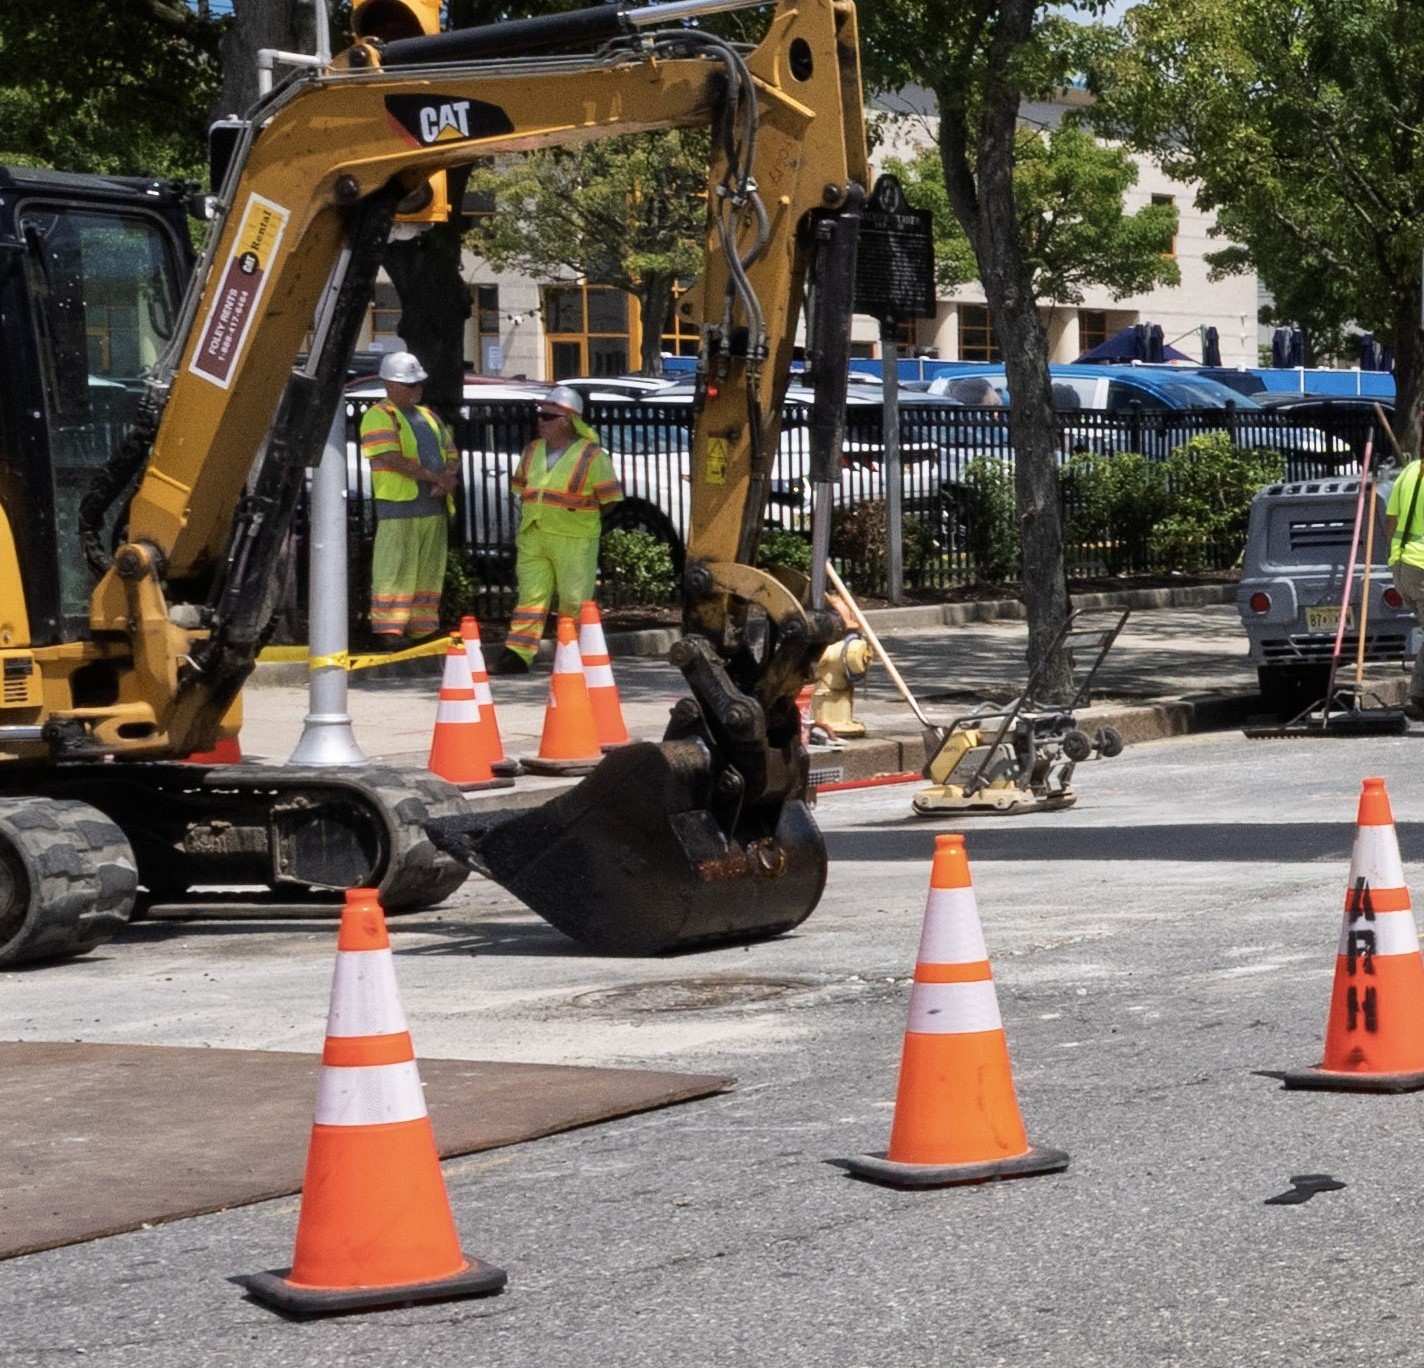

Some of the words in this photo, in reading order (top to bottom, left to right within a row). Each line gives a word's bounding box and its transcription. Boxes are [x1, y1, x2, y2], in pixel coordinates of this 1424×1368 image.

[420, 101, 470, 142] CAT
[243, 254, 256, 273] CAT
[251, 210, 271, 251] Rental
[208, 322, 225, 355] FOLEY
[220, 288, 239, 323] RENTS
[1346, 876, 1378, 1033] ARH
